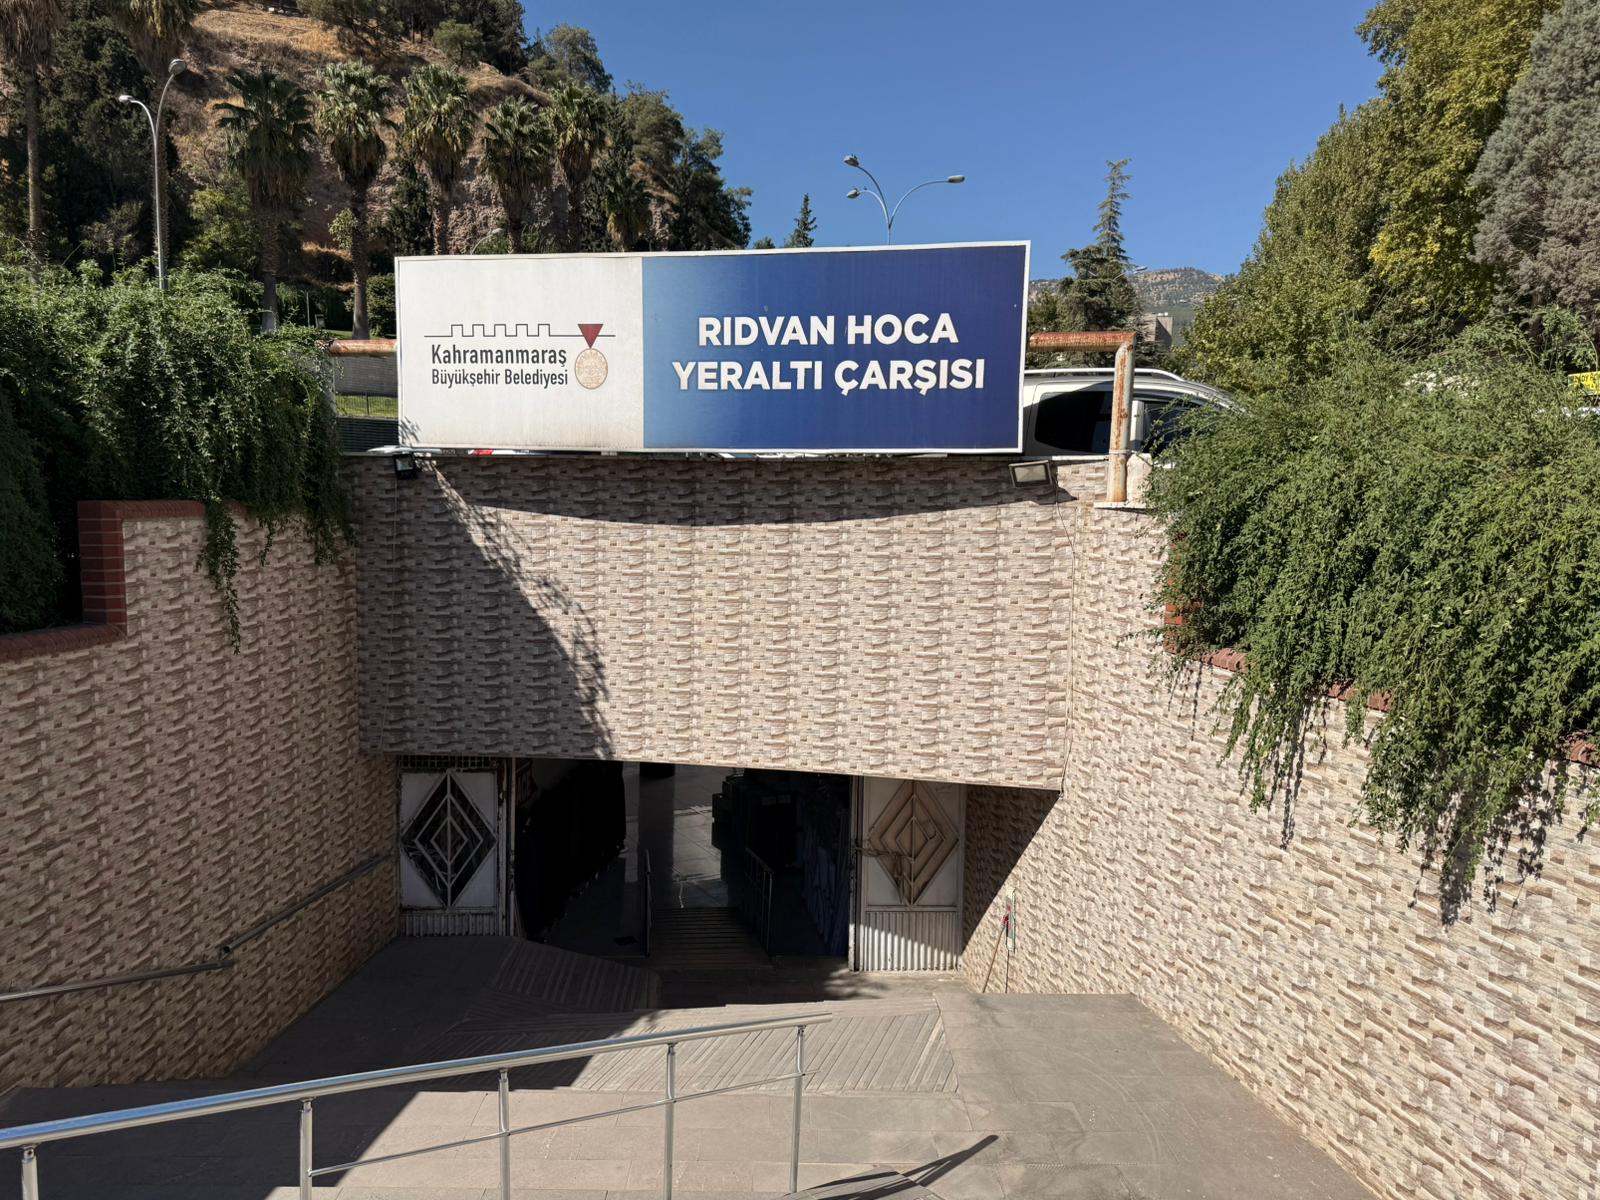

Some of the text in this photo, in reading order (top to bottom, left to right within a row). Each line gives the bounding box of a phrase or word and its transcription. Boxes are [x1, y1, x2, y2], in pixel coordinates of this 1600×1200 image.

[698, 312, 959, 346] RIDVAN HOCA
[431, 344, 567, 367] Kahramanmaraş
[431, 369, 568, 389] Büyükşehir Belediyesi
[672, 358, 985, 396] YERALTI ÇARŞISI
